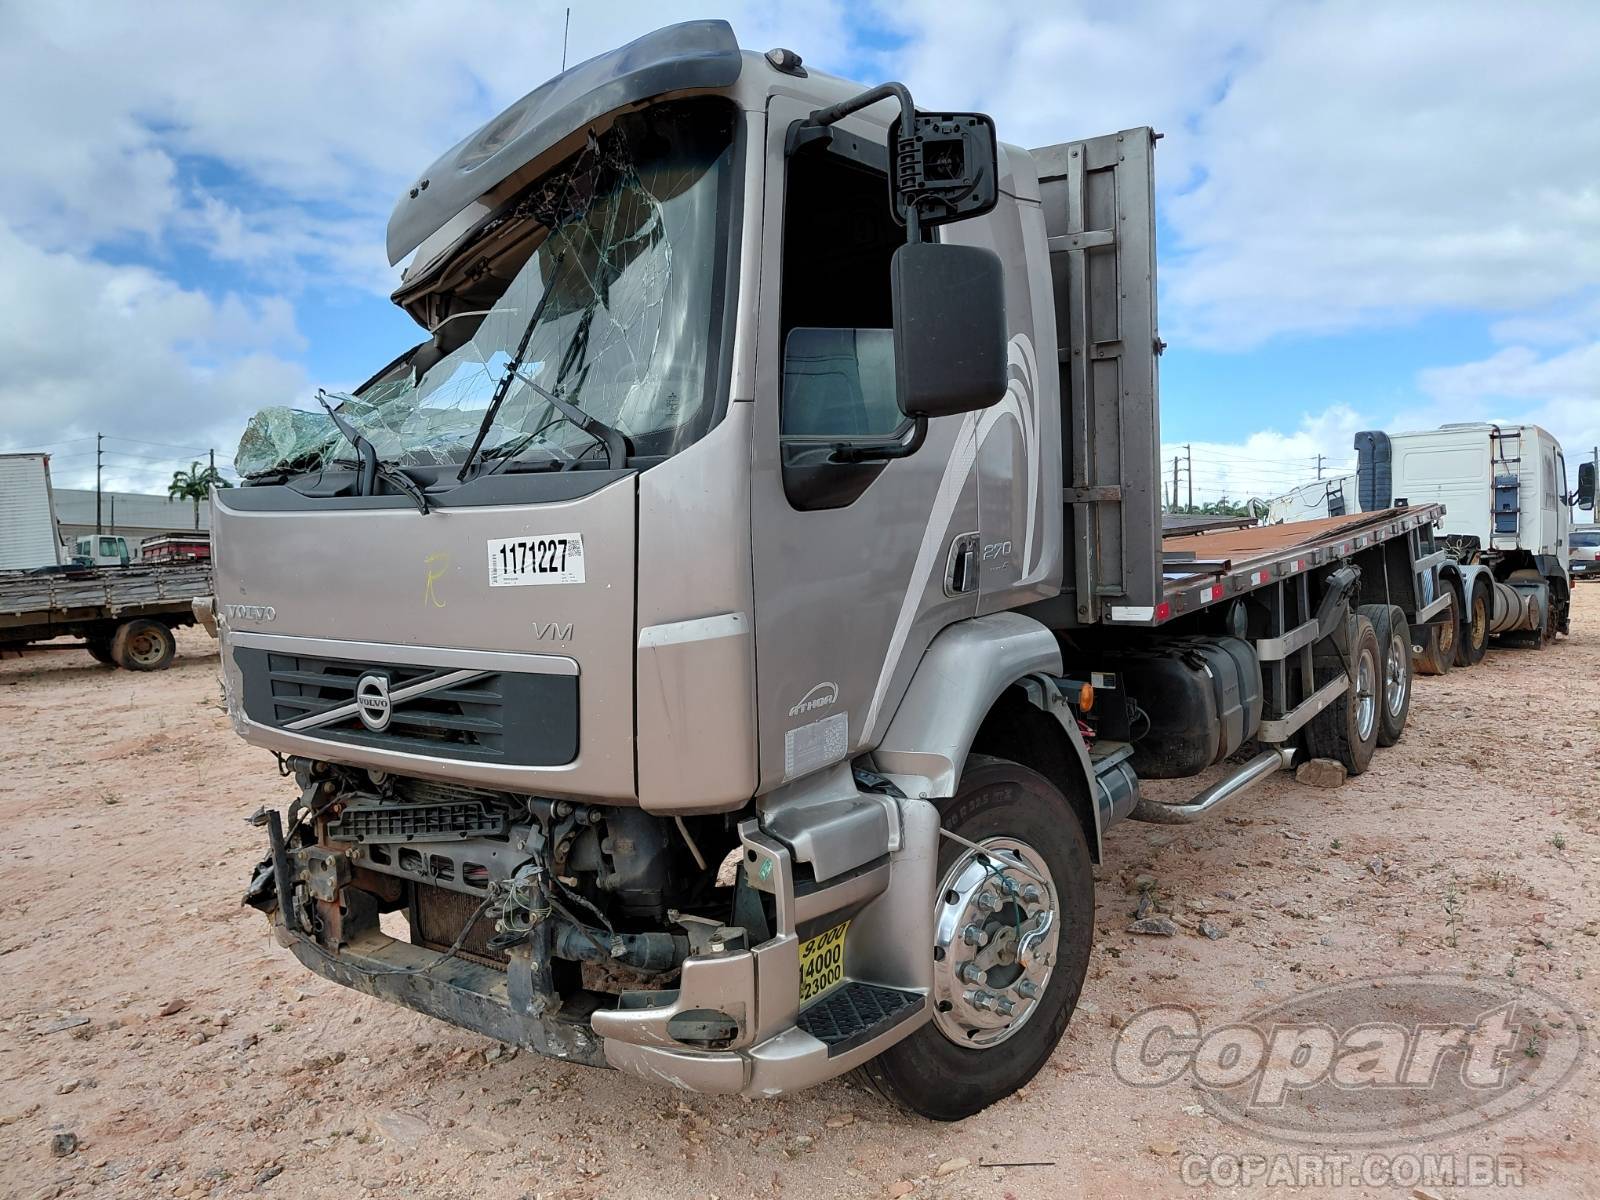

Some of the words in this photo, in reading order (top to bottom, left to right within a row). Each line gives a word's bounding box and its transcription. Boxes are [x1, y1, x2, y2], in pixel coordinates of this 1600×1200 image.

[500, 539, 567, 575] 1171227
[983, 541, 1012, 560] 270
[224, 604, 276, 621] VOLVO
[532, 621, 574, 641] VM
[359, 697, 388, 708] VOLVO
[802, 922, 847, 959] 9.000
